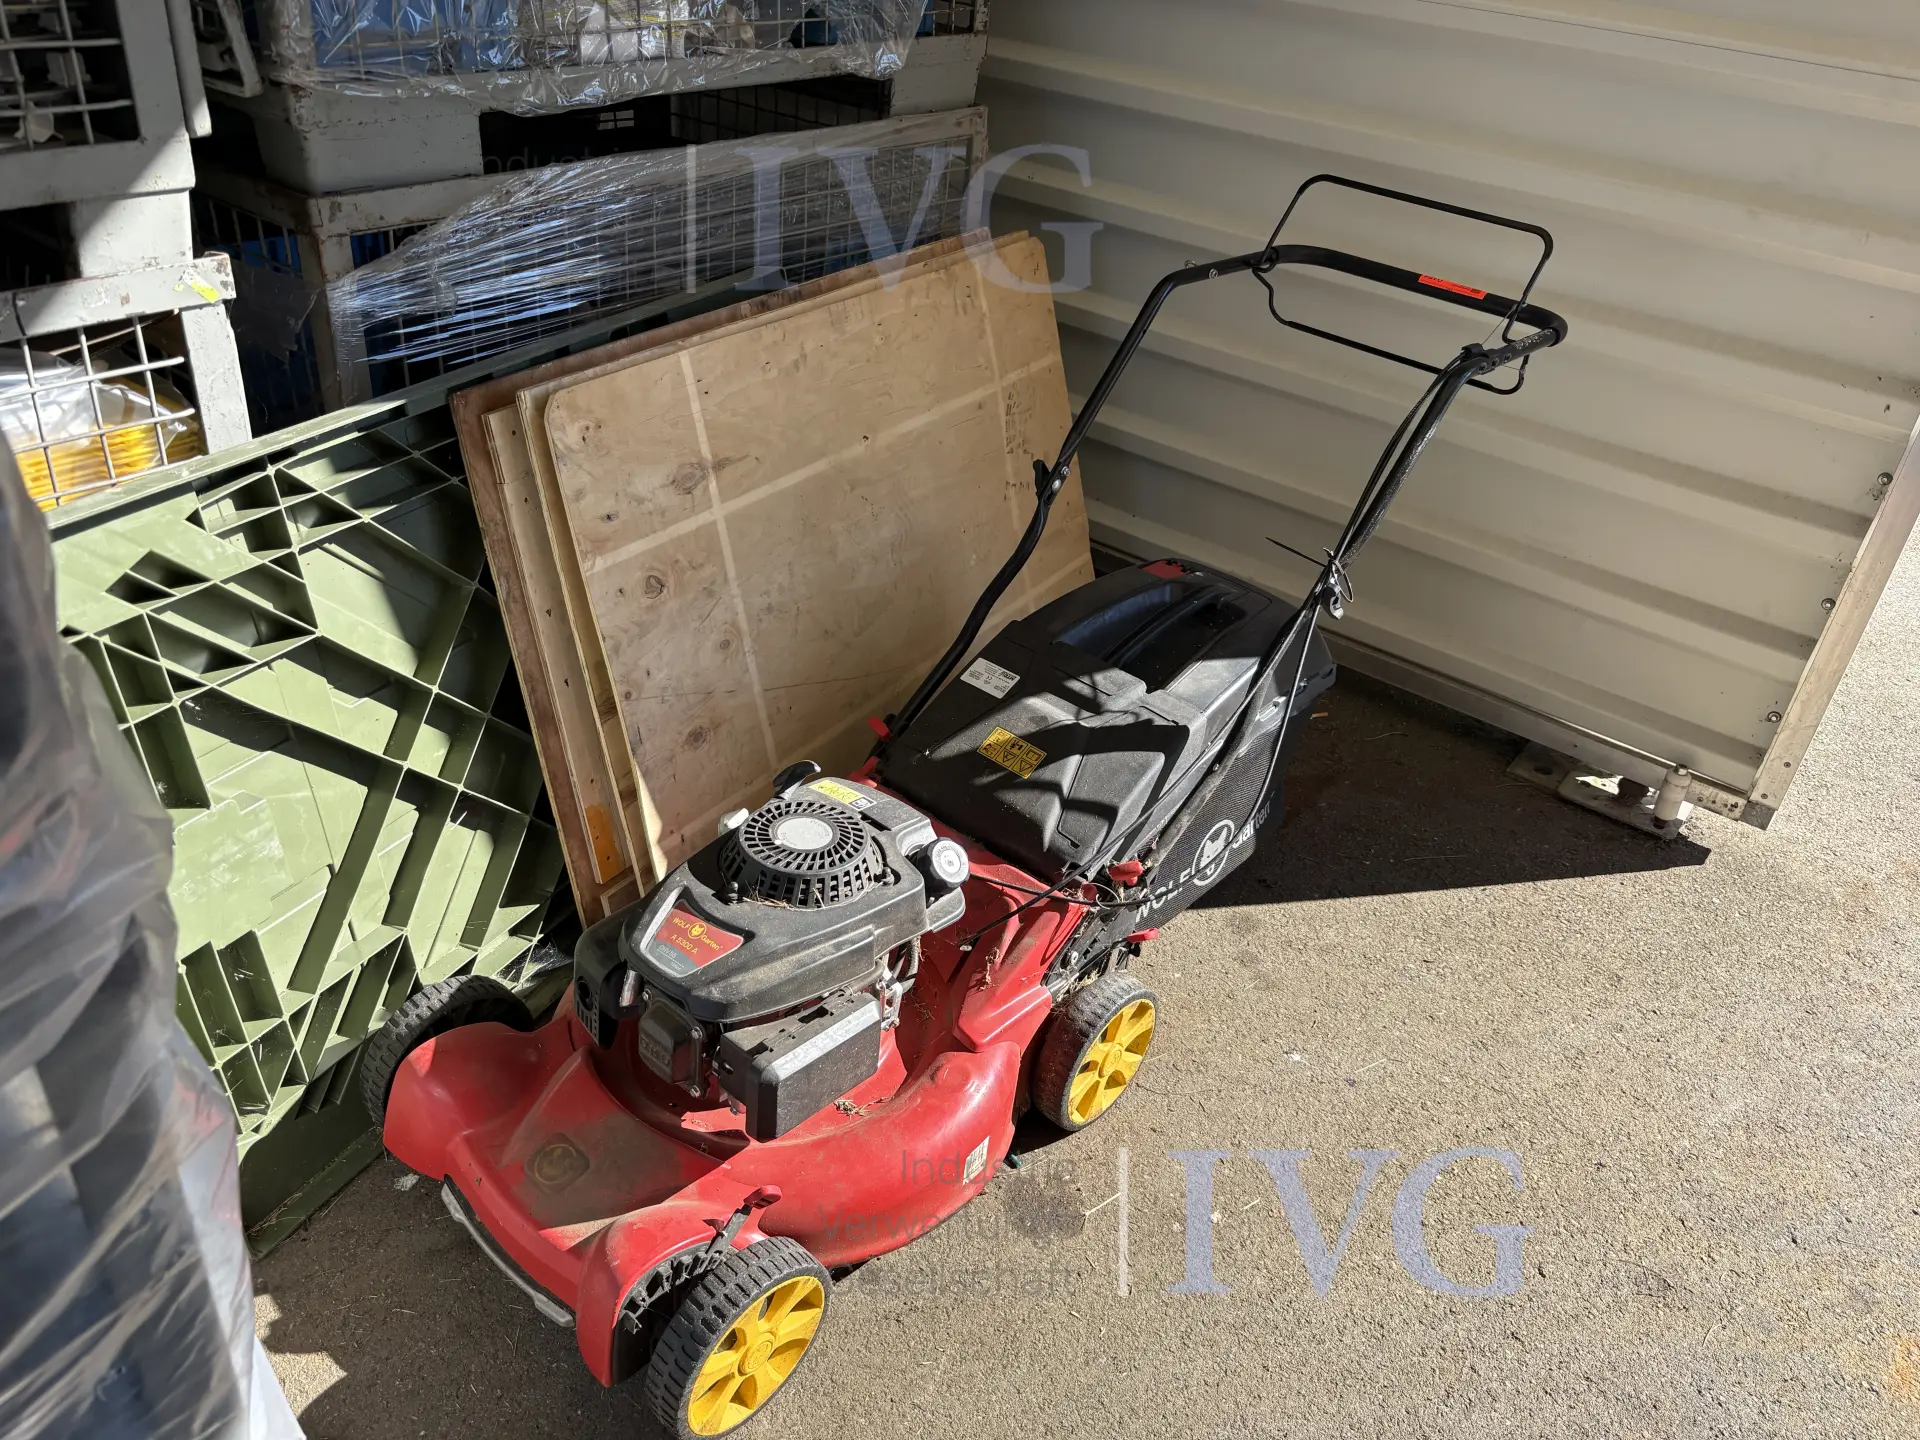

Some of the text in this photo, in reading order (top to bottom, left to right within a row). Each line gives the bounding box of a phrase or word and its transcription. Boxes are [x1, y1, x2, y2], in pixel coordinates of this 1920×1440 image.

[672, 916, 691, 929] WOLF
[675, 936, 694, 950] 5300
[700, 934, 720, 951] Garten
